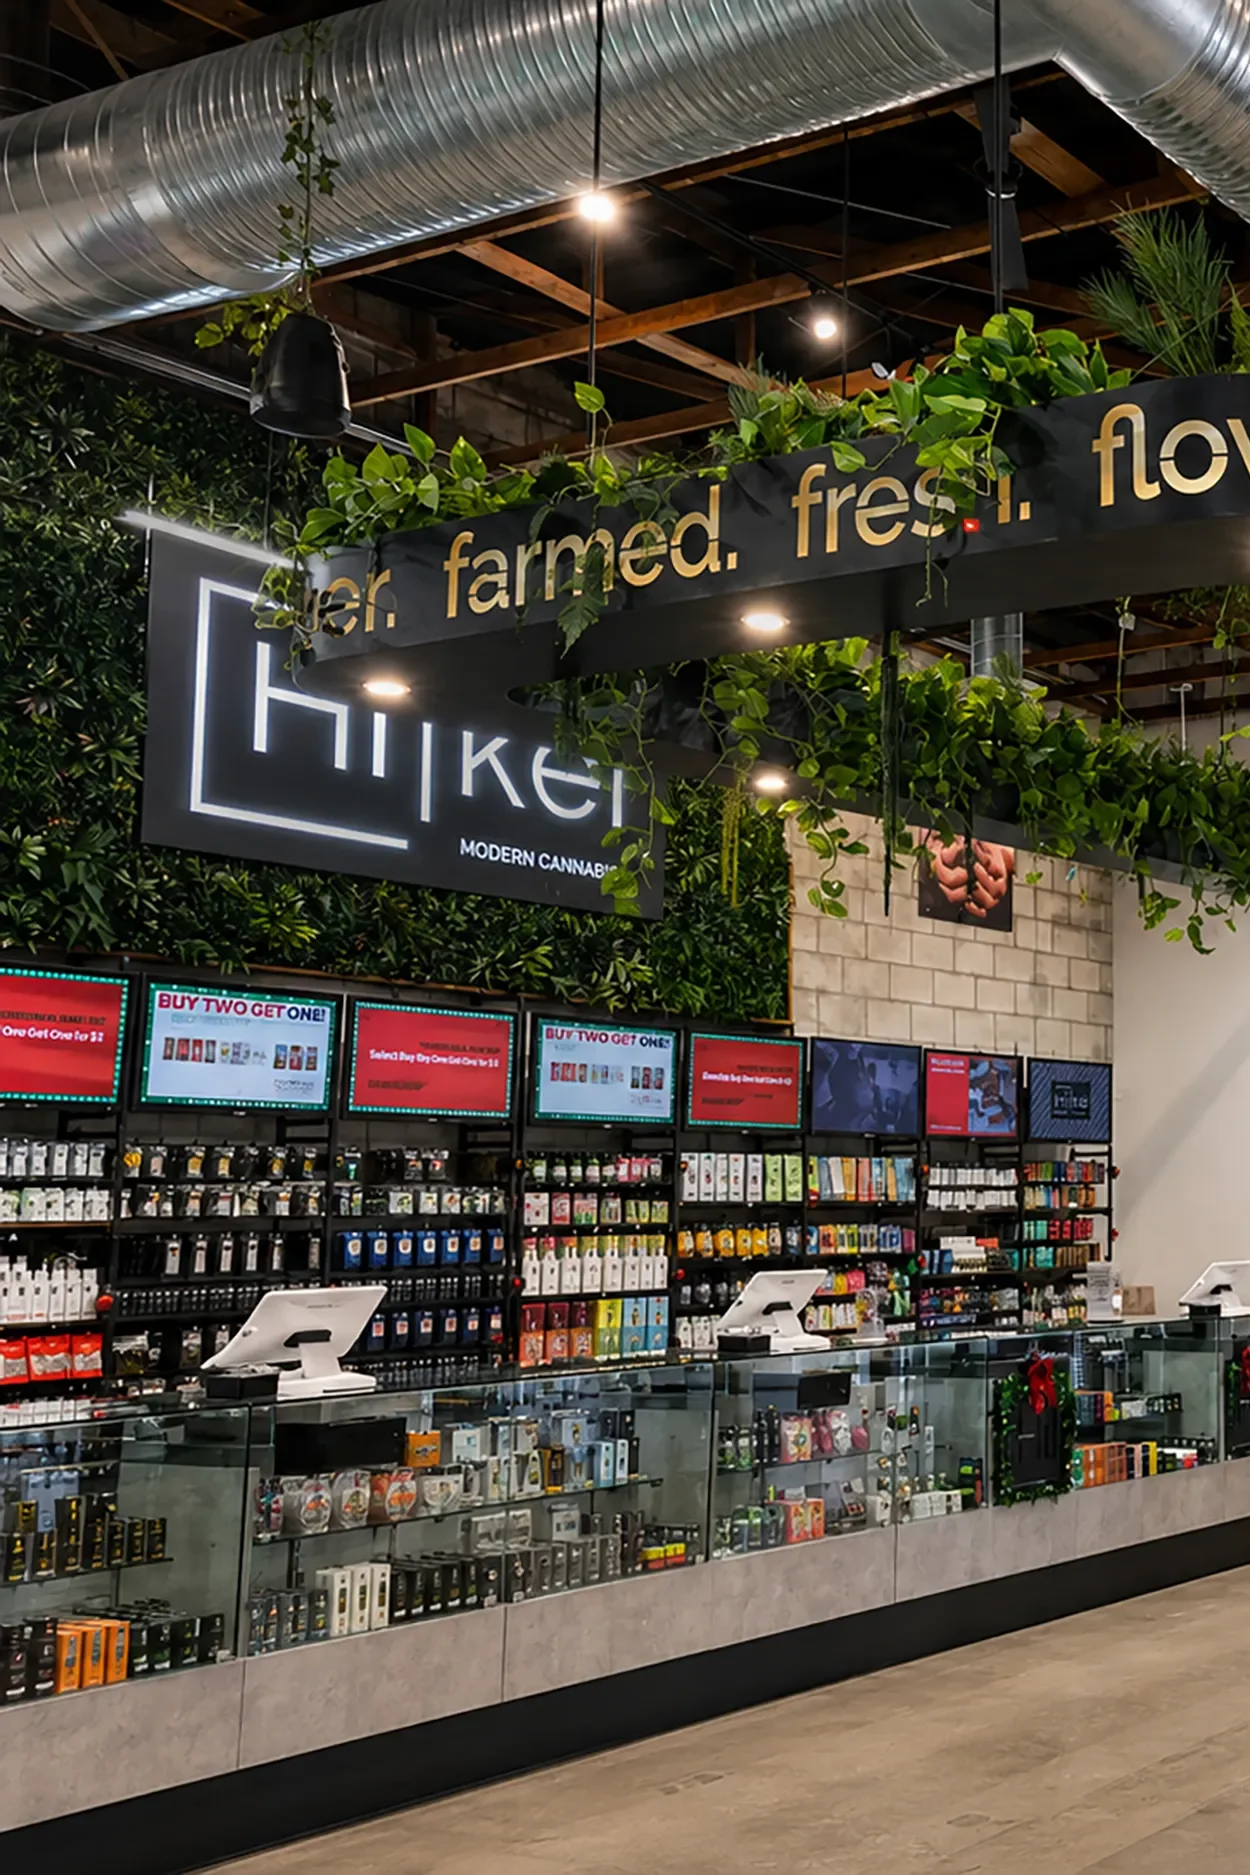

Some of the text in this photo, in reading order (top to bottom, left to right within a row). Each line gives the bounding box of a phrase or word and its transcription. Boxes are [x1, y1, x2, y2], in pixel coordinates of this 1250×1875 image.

[443, 484, 738, 619] farmed.
[459, 838, 535, 868] MODERN
[158, 993, 326, 1022] BUY TWO GET ONE!
[545, 1027, 573, 1040] BUY
[575, 1030, 609, 1043] TWO
[611, 1034, 637, 1046] GET
